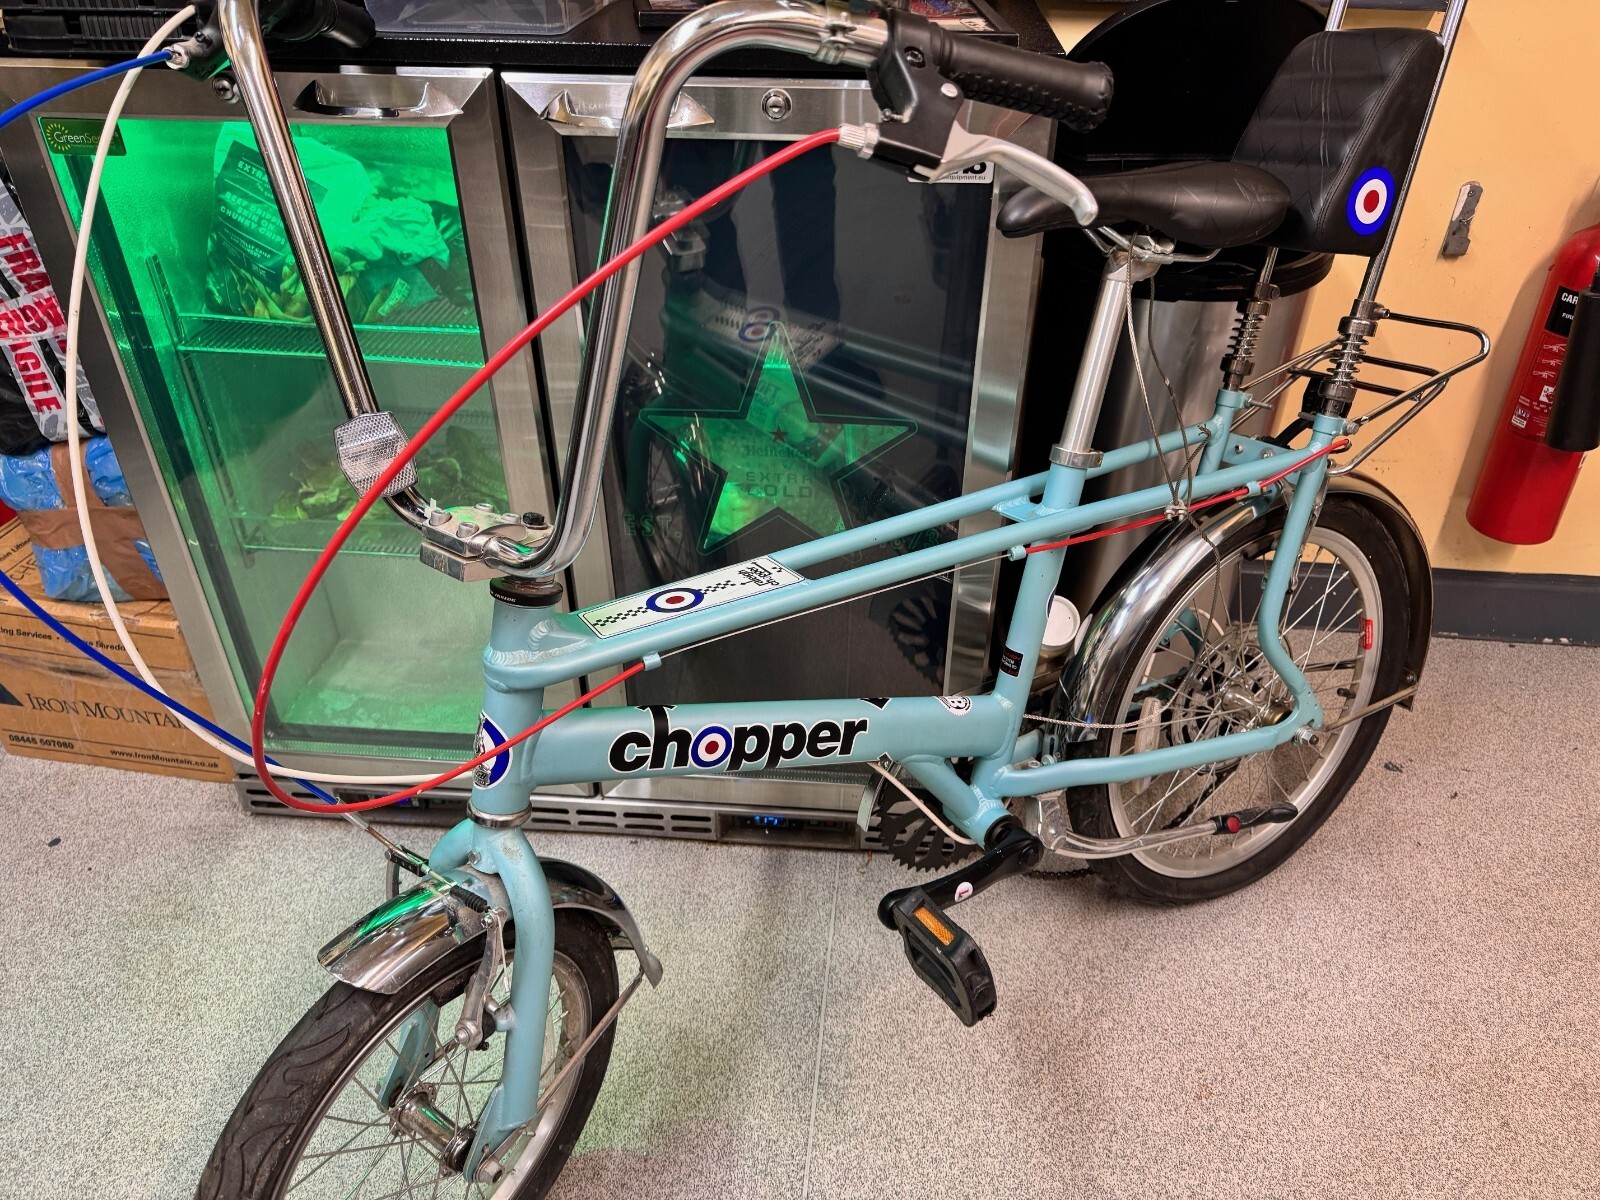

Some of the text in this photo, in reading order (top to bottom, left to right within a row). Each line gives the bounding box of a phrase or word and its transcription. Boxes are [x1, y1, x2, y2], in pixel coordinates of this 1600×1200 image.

[225, 191, 249, 207] BEEF
[260, 219, 276, 231] ON
[1561, 292, 1579, 305] CAR
[745, 471, 813, 484] EXTRA
[16, 628, 53, 641] Services
[26, 692, 188, 730] IRON MOUNTAI
[9, 734, 38, 745] 08445
[608, 703, 869, 772] chopper
[110, 749, 219, 769] www.IronMountain.co.uk
